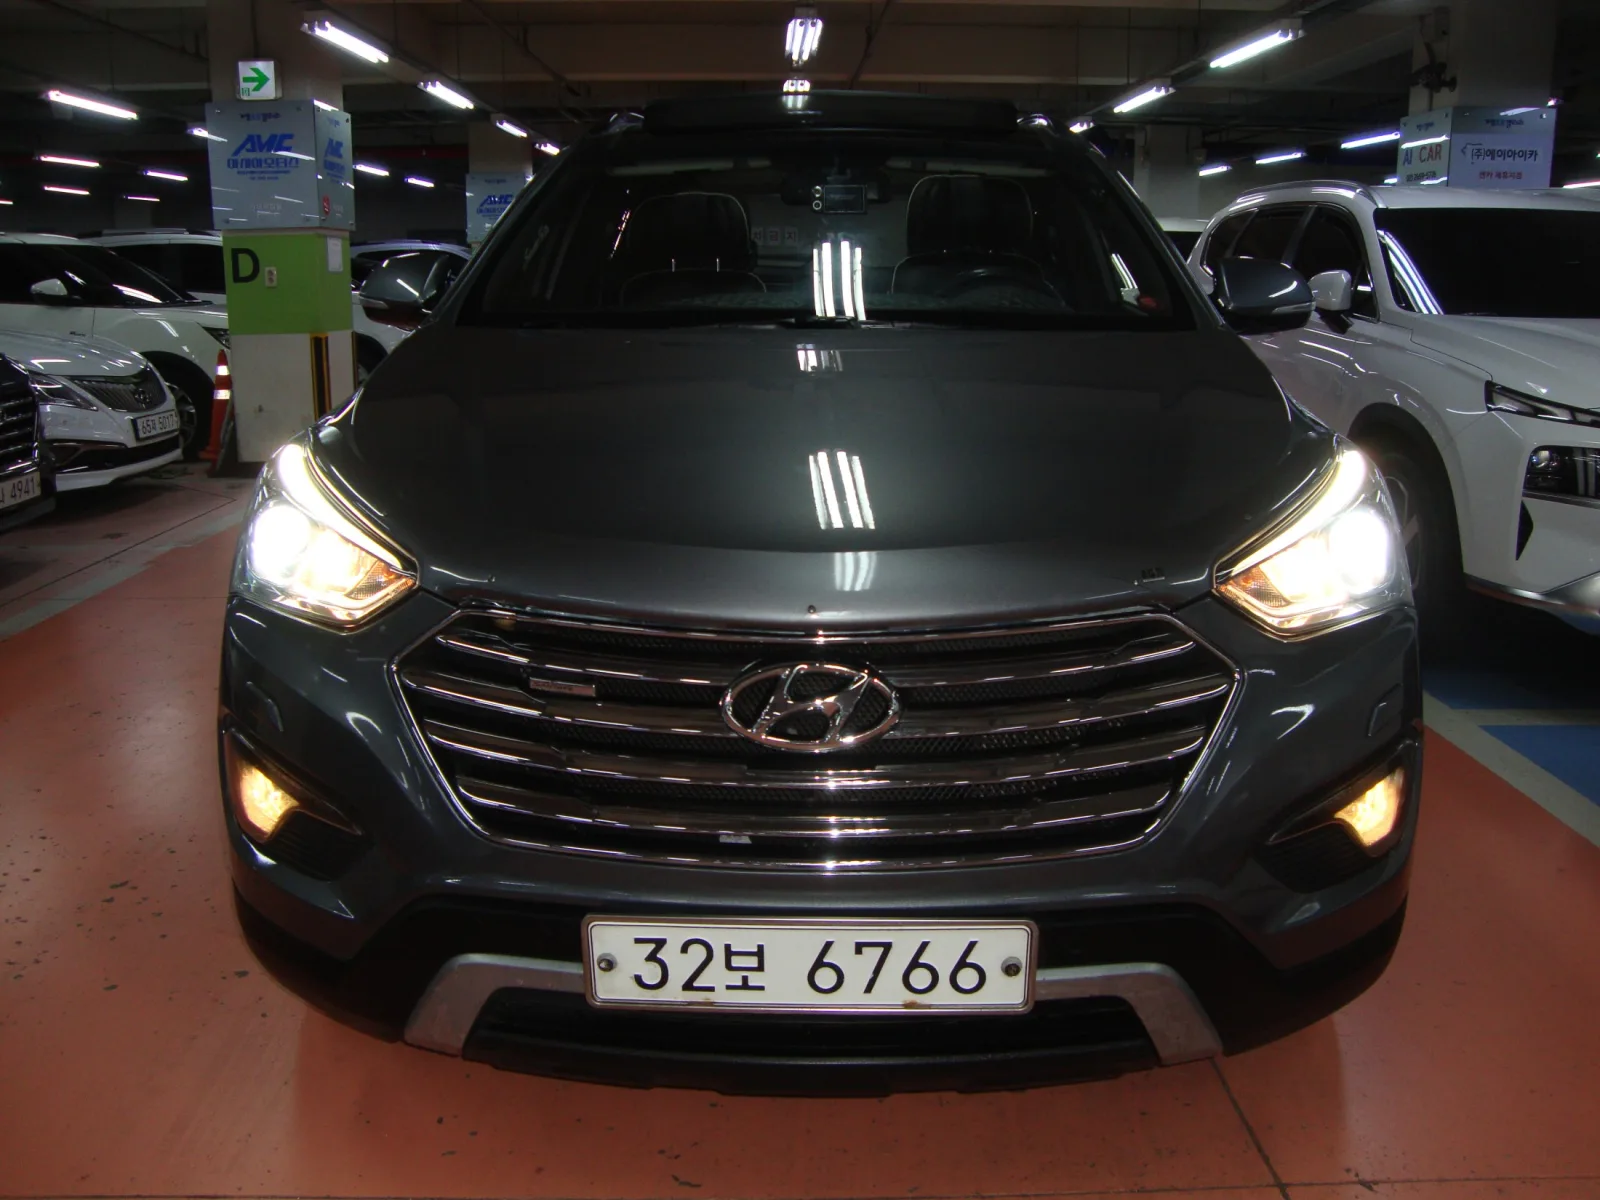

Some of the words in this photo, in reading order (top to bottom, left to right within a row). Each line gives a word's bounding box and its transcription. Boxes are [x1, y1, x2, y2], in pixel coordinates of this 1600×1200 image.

[231, 133, 294, 157] AMC
[1419, 144, 1442, 163] CAR
[1471, 148, 1538, 161] (주)에이아이카
[231, 247, 260, 284] D
[10, 476, 35, 500] 4941
[633, 937, 765, 993] 32보
[807, 940, 987, 994] 6766
